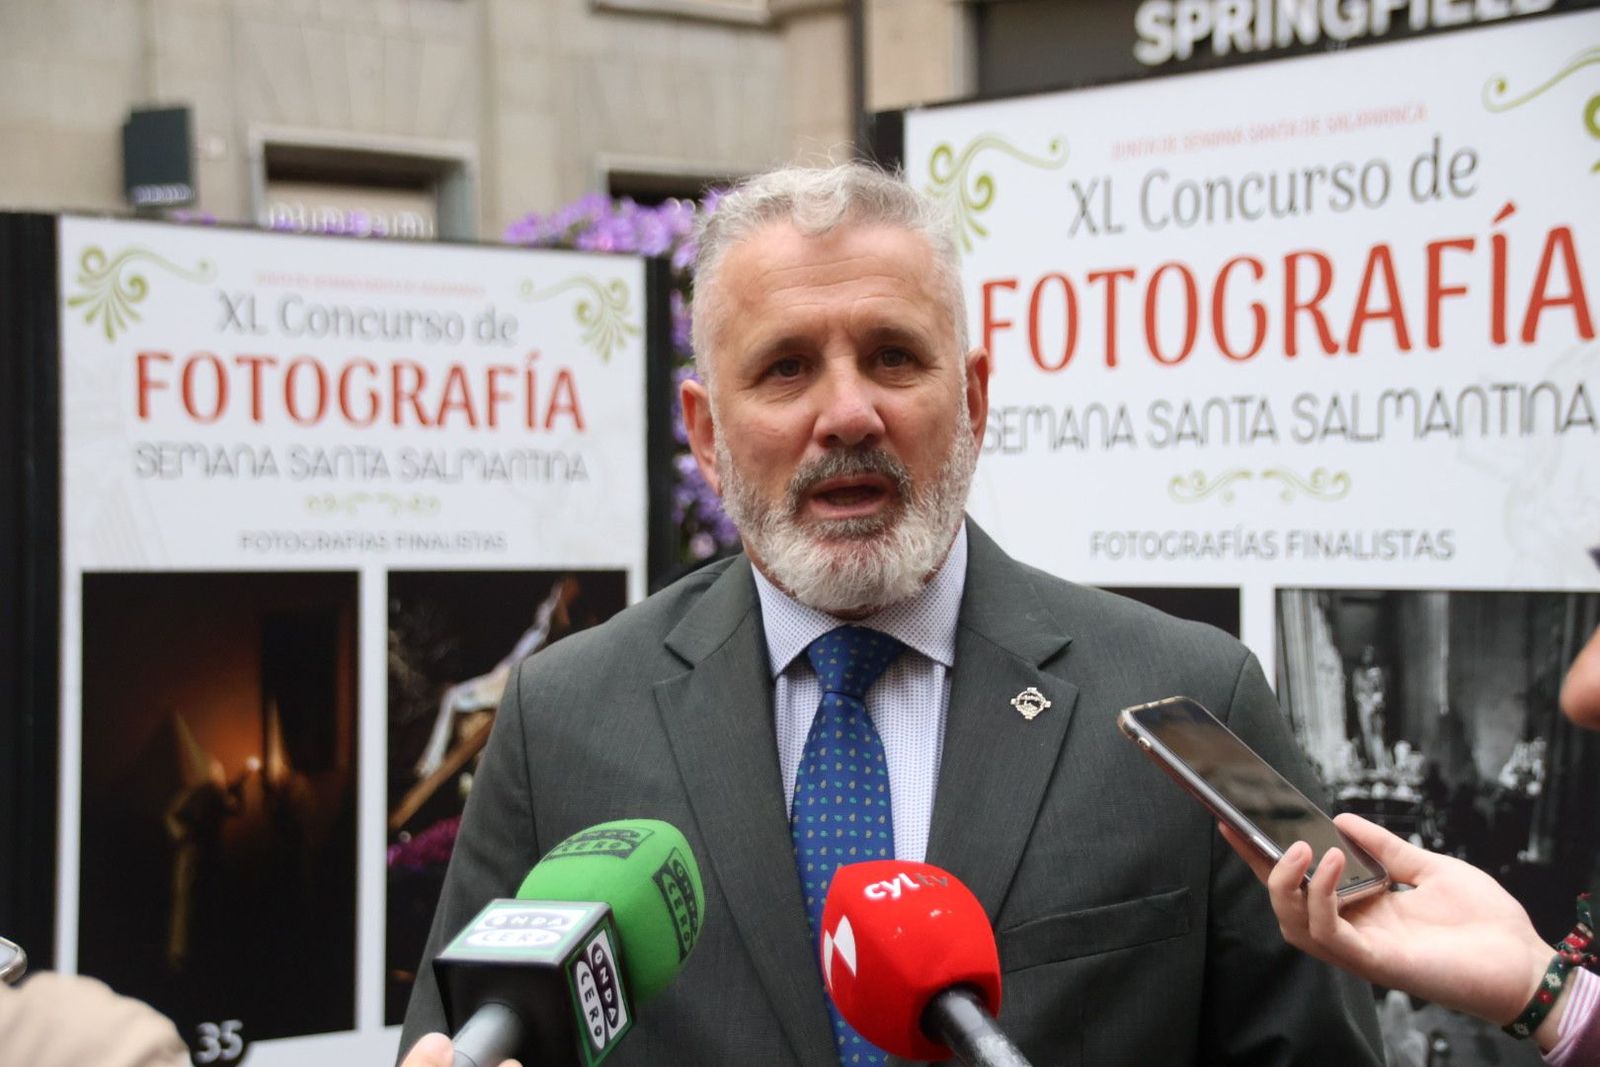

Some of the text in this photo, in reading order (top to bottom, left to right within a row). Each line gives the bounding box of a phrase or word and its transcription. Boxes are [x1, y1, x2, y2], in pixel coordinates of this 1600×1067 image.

[1133, 0, 1556, 66] SPRINGF
[1069, 134, 1479, 238] XL Concurso de
[217, 290, 519, 346] XL Concurso de
[980, 200, 1597, 376] FOTOGRAFÍA
[135, 350, 587, 433] FOTOGRAFÍA
[983, 380, 1599, 456] SEMANA SANTA SALMANTINA
[135, 442, 589, 483] SEMANA SANTA SALMANTINA
[1089, 523, 1457, 562] FOTOGRAFÍAS FINALISTAS
[481, 930, 555, 943] CERO
[492, 914, 567, 928] ONDA
[667, 880, 691, 943] CERO
[579, 969, 603, 1038] CERO
[592, 946, 618, 1023] ONDA
[196, 1019, 243, 1063] 35
